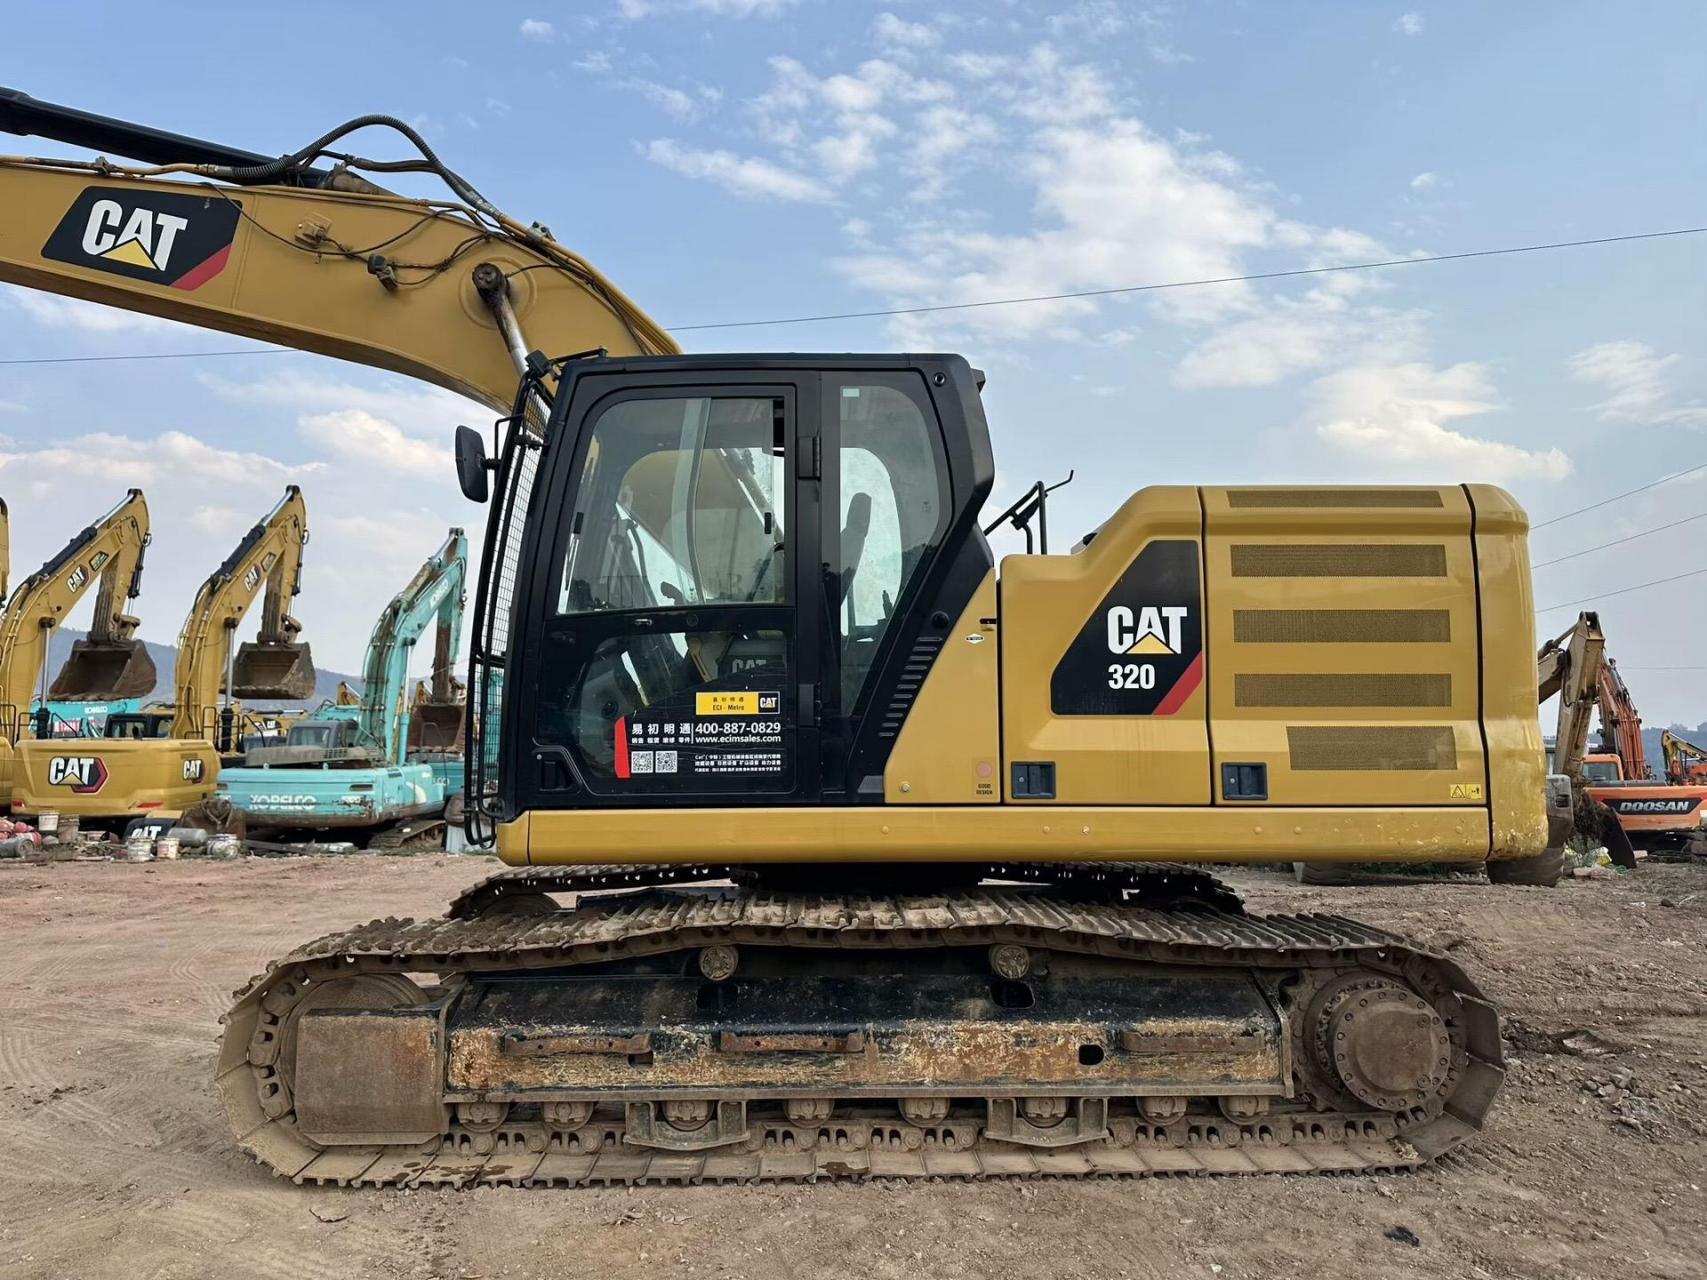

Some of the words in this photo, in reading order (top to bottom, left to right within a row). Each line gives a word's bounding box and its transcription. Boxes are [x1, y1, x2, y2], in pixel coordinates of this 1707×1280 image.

[82, 199, 188, 271] CAT
[67, 566, 85, 593] CAT
[244, 566, 258, 591] CAT
[1107, 606, 1187, 654] CAT
[1108, 664, 1155, 690] 320
[760, 697, 777, 708] CAT
[632, 723, 690, 734] 易初明通
[695, 722, 781, 734] 400-887-0829
[695, 734, 781, 743] www.ecimsales.com
[50, 757, 94, 785] CAT
[183, 759, 201, 780] CAT
[249, 794, 317, 810] KOBELCO
[1620, 801, 1689, 811] DOOSAN
